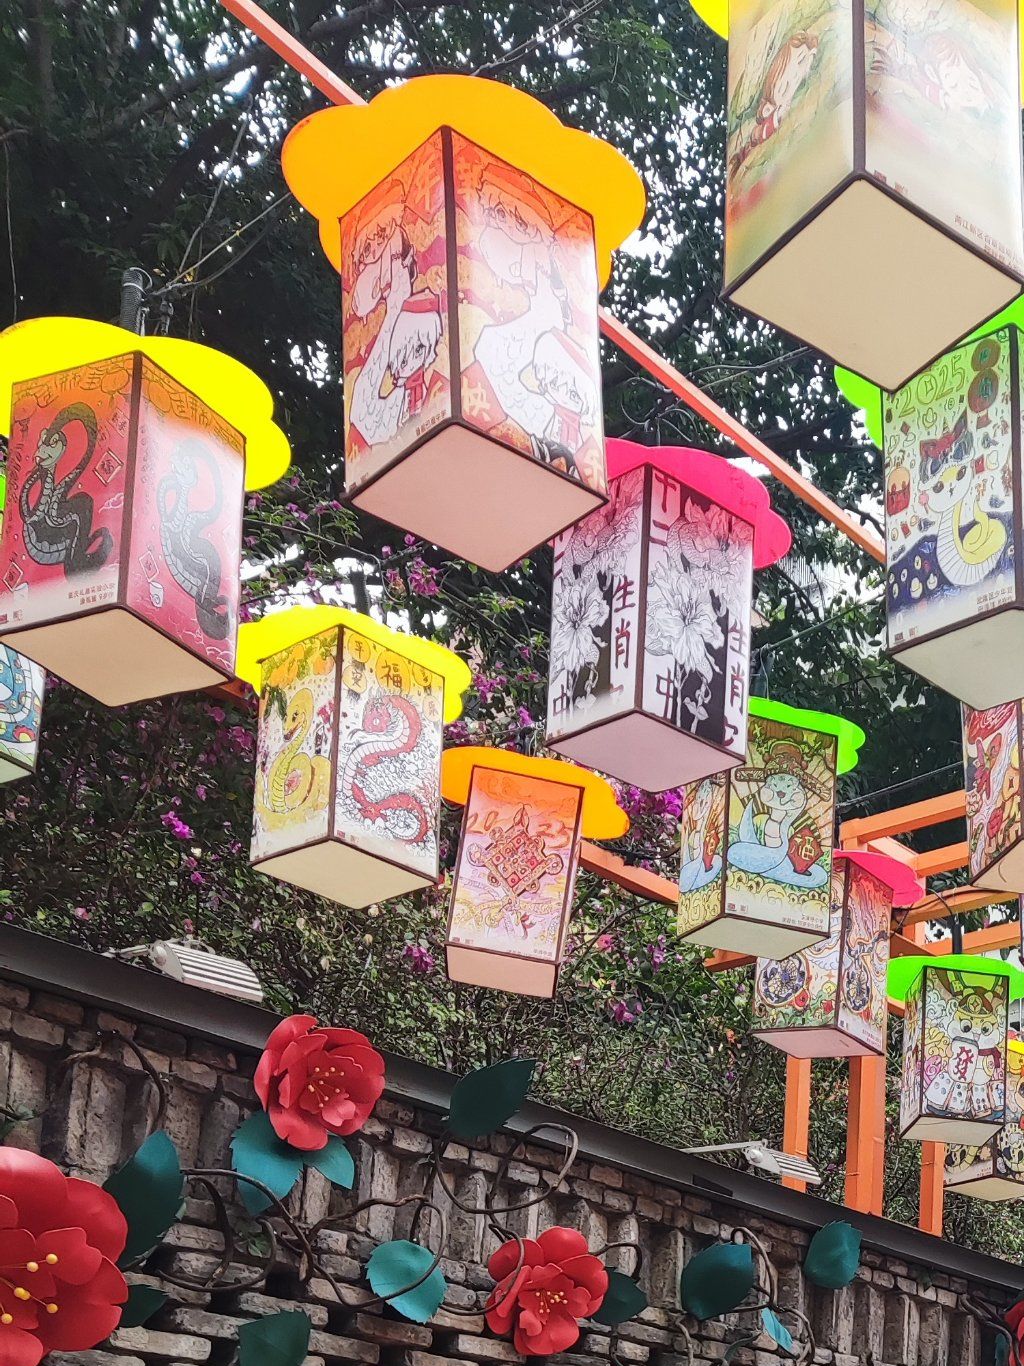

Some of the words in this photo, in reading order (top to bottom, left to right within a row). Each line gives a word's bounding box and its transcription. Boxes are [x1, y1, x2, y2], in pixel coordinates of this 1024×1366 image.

[613, 575, 636, 670] 生肖
[380, 662, 403, 690] 福
[655, 667, 674, 719] 中
